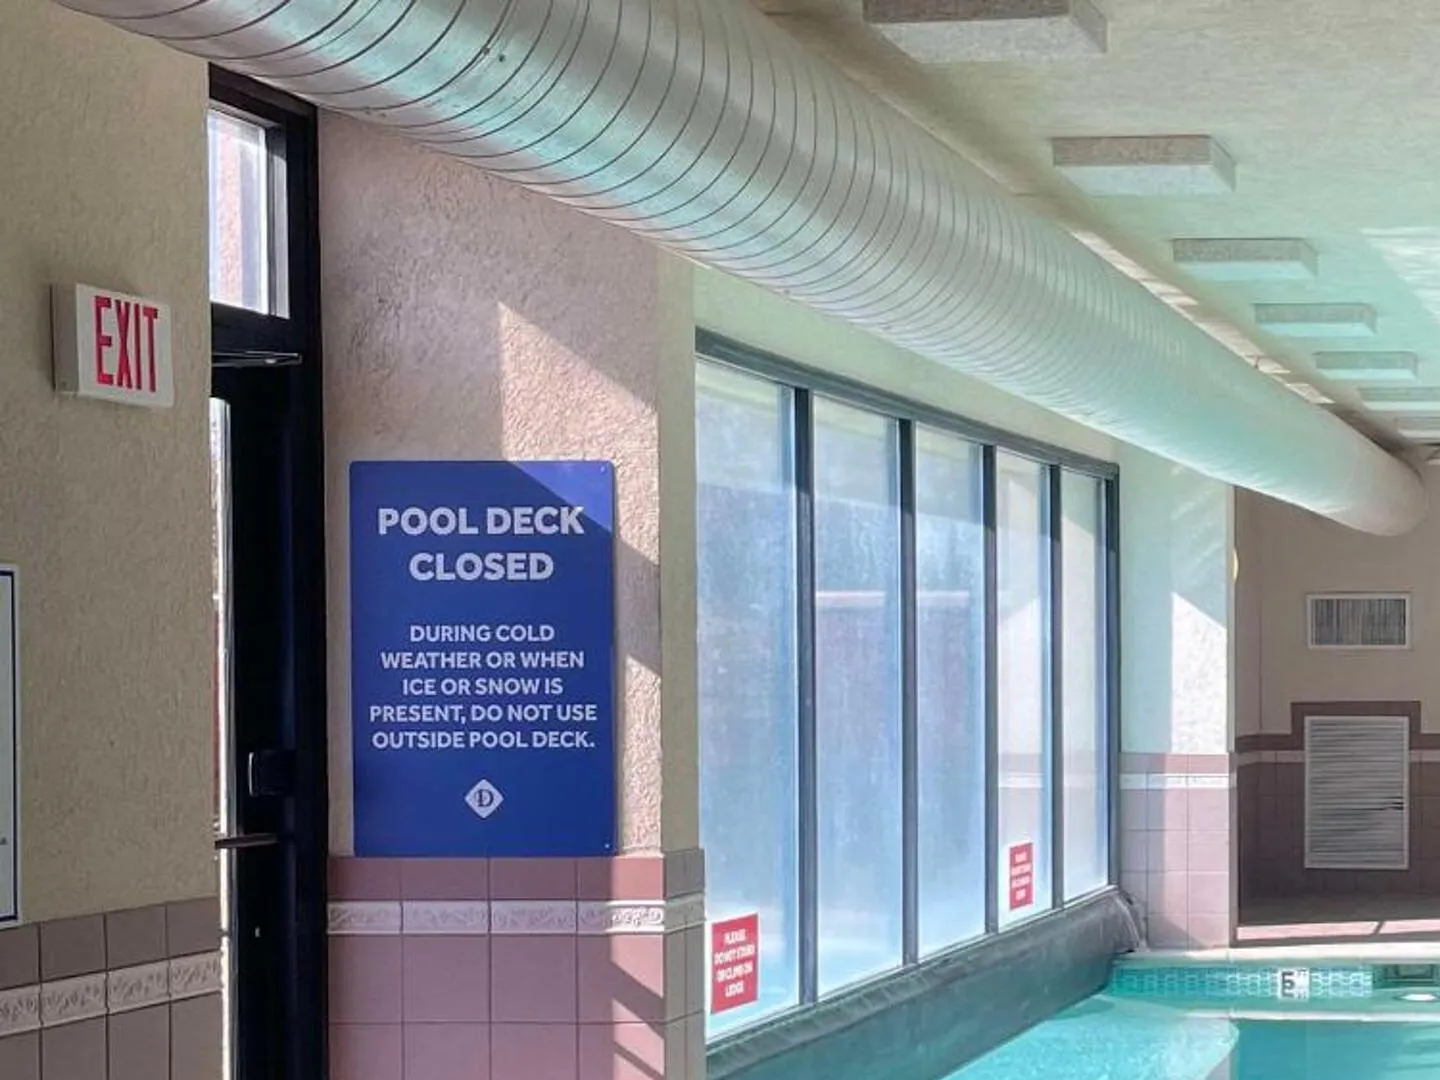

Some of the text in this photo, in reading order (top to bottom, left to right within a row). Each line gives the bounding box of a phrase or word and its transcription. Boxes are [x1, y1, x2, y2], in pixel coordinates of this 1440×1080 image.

[94, 294, 158, 392] EXIT
[378, 506, 585, 535] POOL DECK
[409, 552, 555, 581] CLOSED
[409, 624, 555, 642] DURING COLD
[380, 650, 585, 669] WEATHER OR WHEN
[402, 677, 564, 696] ICE OR SNOW IS
[369, 703, 598, 725] PRESENT, DO NOT USE
[371, 730, 596, 749] OUTSIDE POOL DECK.
